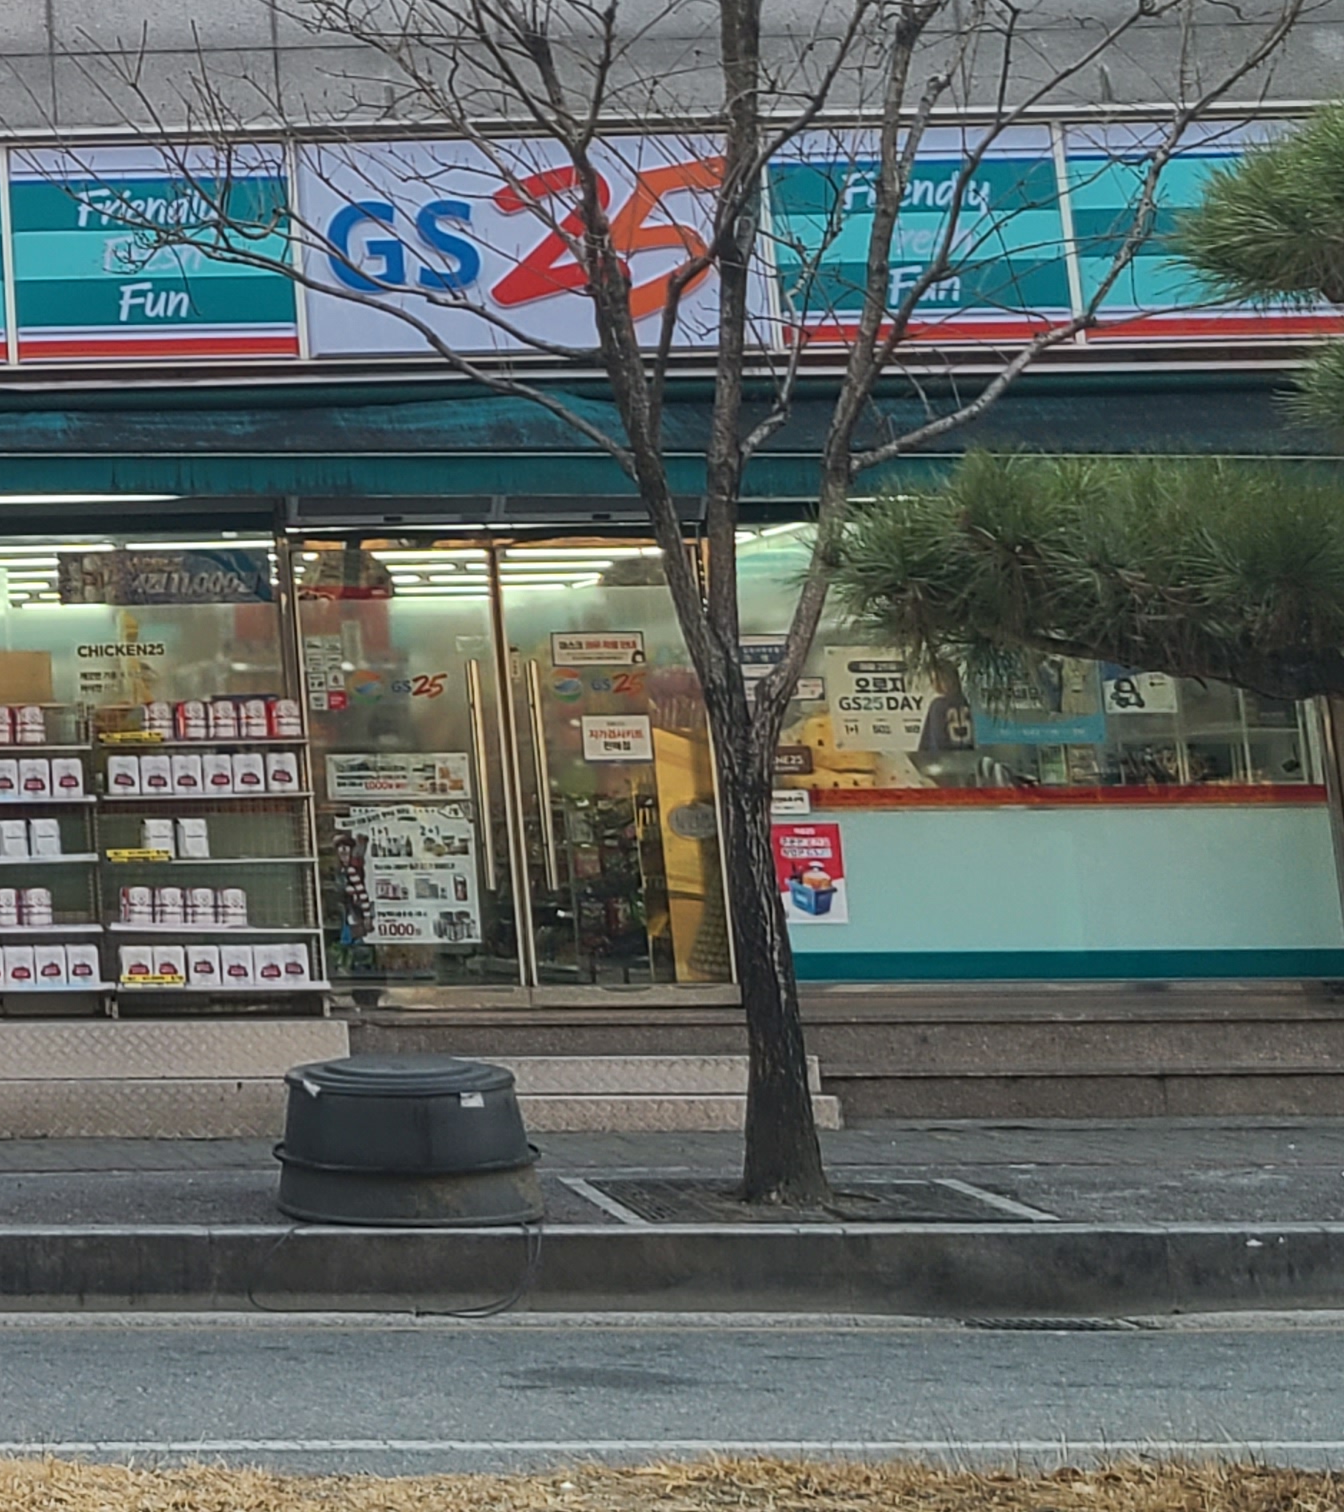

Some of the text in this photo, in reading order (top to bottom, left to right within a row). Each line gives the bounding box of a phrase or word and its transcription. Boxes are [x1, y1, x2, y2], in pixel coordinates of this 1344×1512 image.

[326, 154, 724, 319] GS25
[119, 282, 190, 321] Fun
[77, 643, 164, 658] CHICKEN25
[391, 673, 447, 698] GS25
